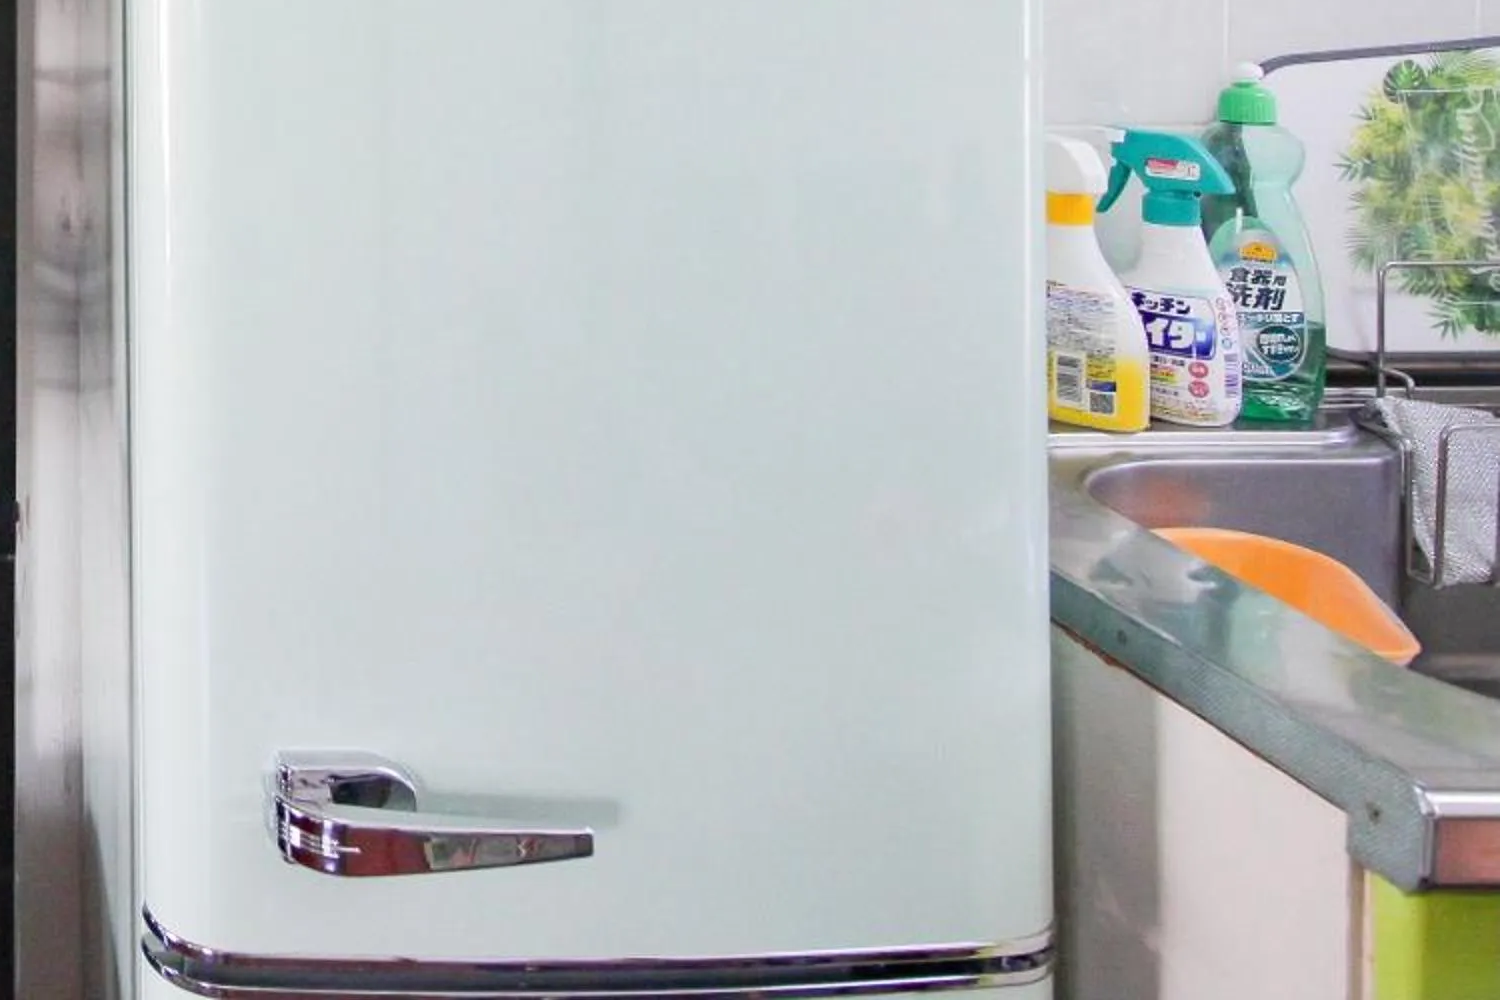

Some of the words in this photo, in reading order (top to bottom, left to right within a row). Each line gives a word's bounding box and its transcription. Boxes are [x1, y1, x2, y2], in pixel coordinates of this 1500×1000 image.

[1230, 267, 1288, 287] 食器用
[1131, 290, 1191, 315] キッチン
[1226, 283, 1288, 311] 洗剤
